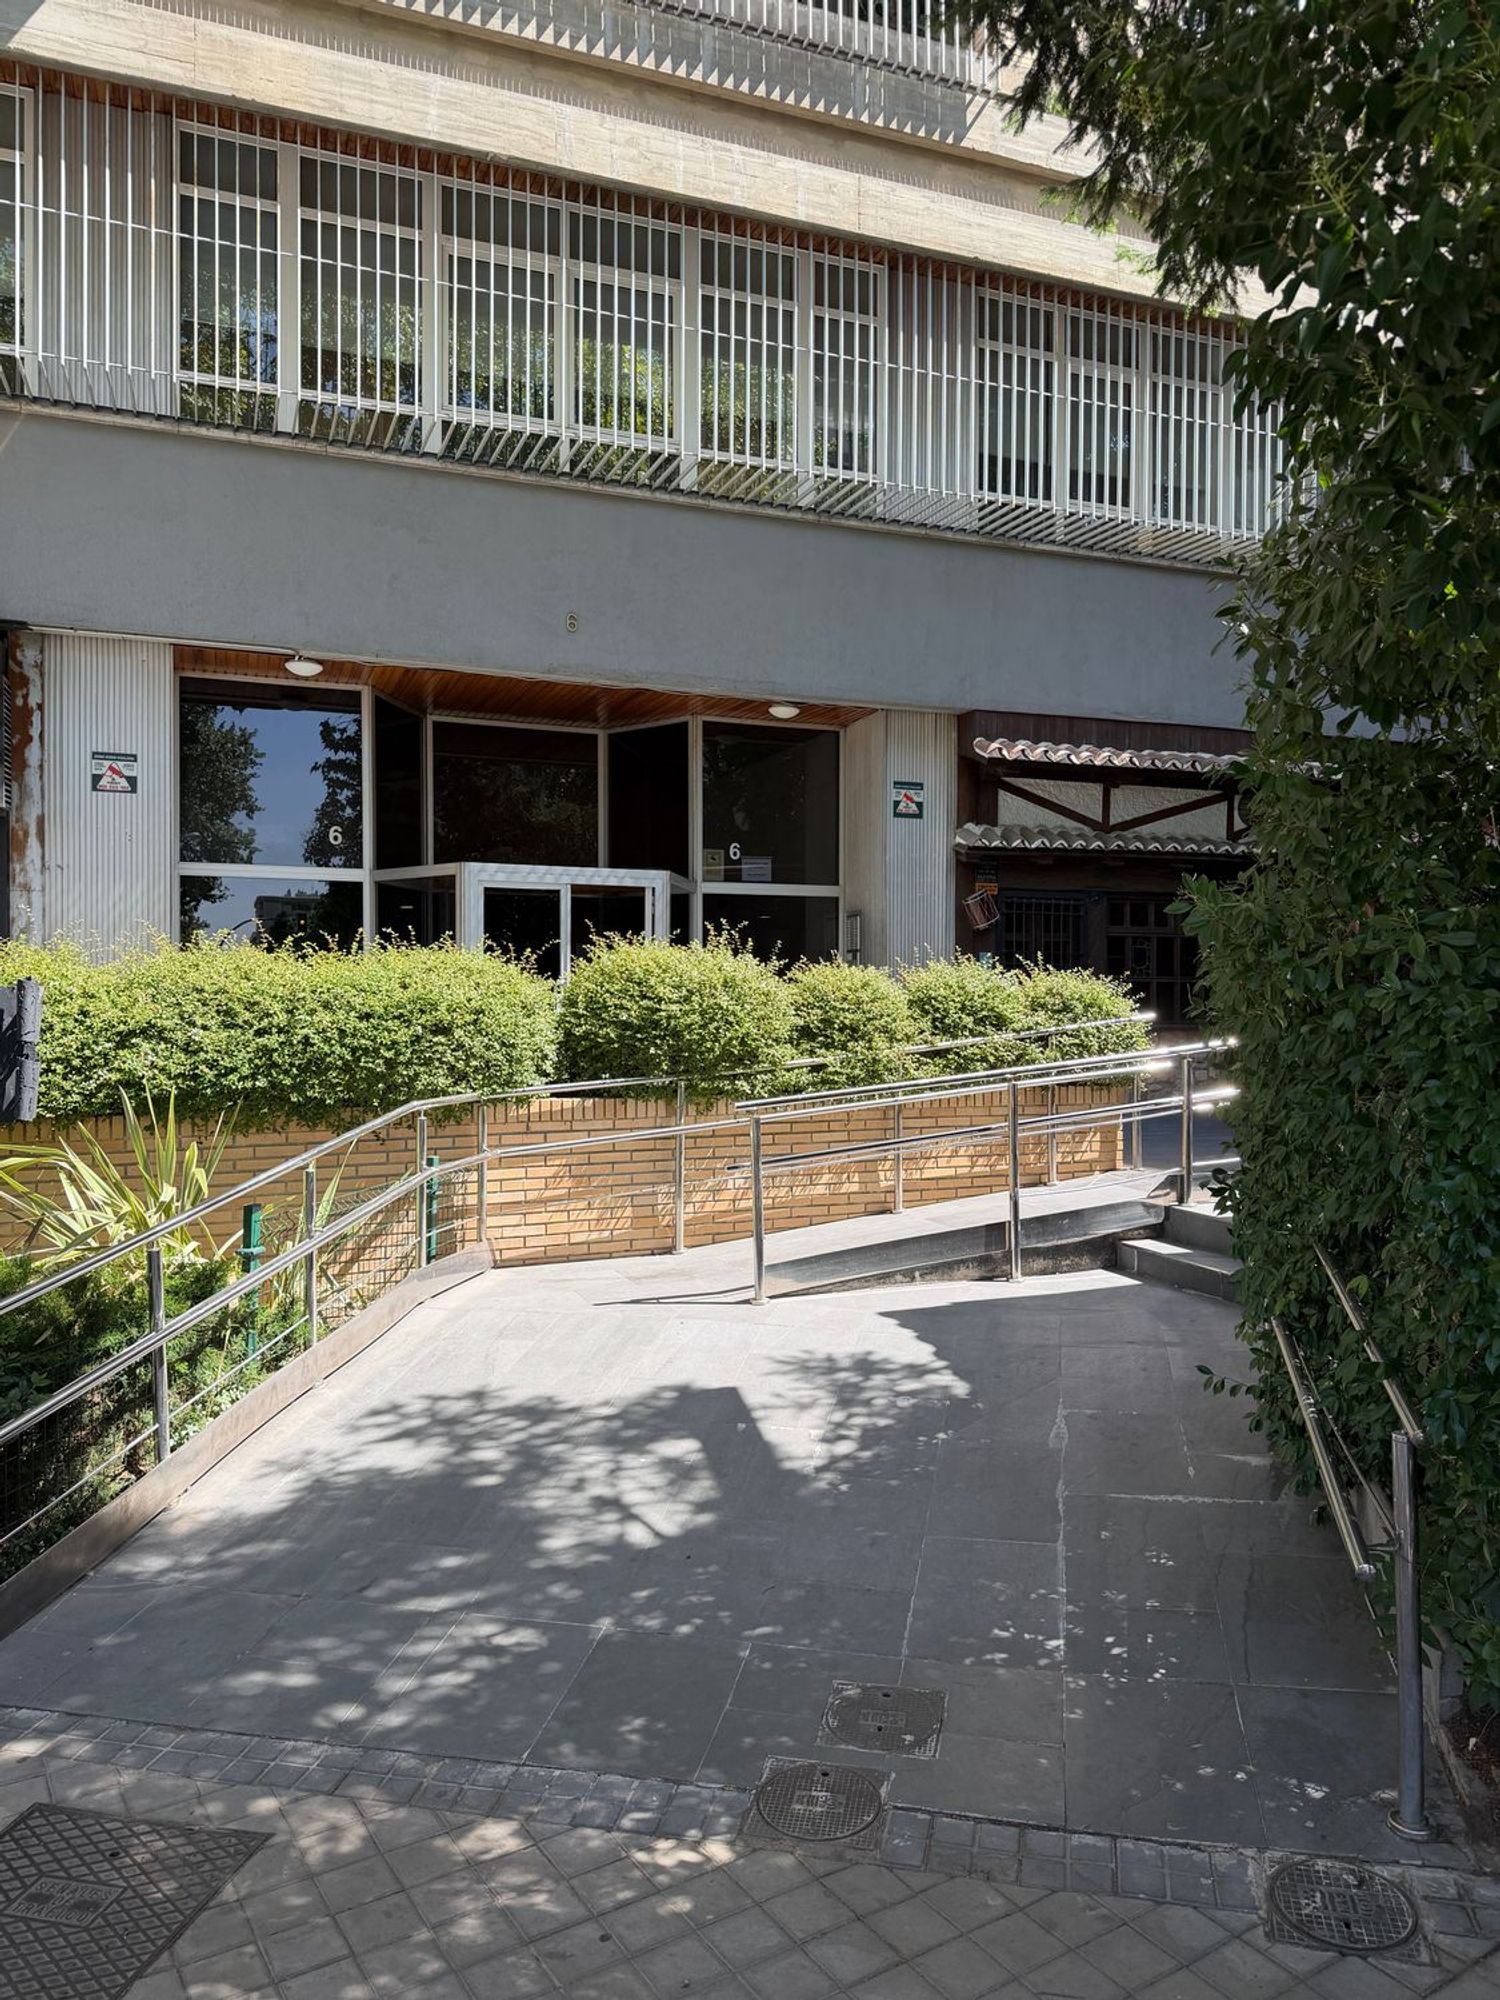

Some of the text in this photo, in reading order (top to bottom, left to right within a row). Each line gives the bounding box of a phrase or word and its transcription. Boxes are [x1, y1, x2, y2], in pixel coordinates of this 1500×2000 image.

[566, 613, 577, 632] 6
[329, 825, 342, 845] 6
[729, 842, 741, 860] 6
